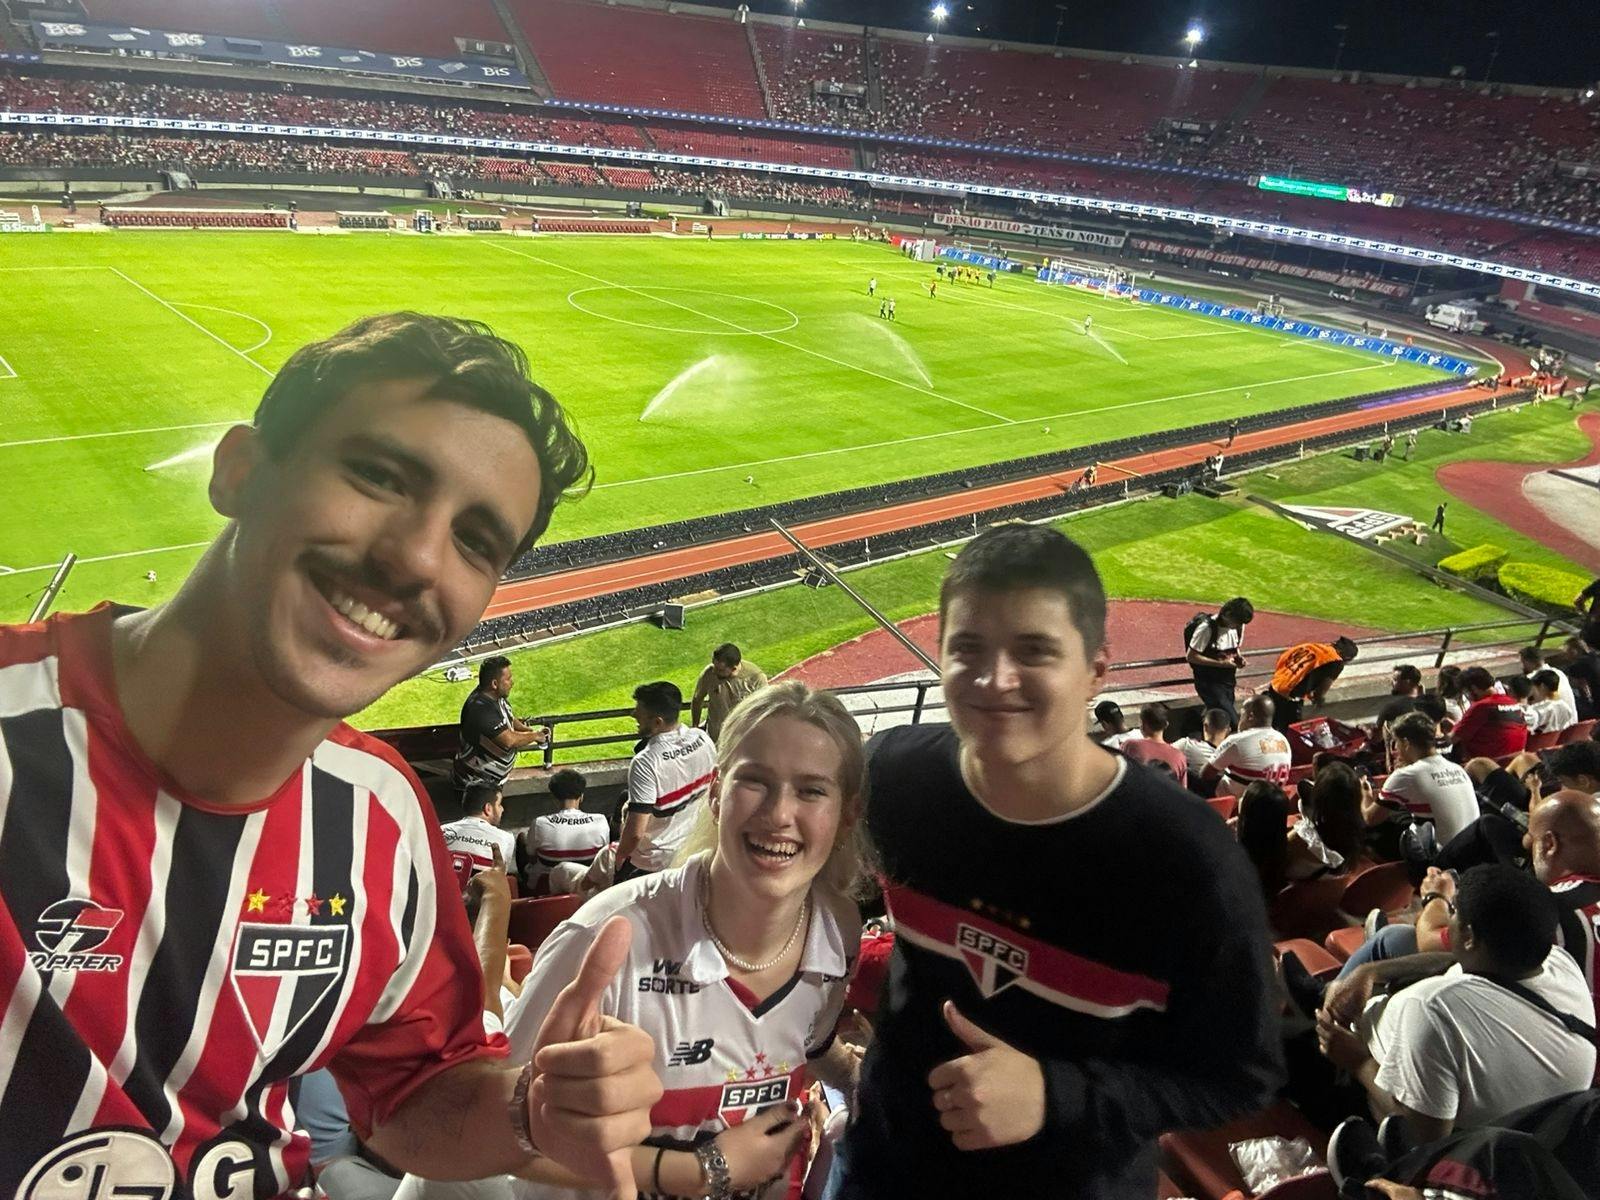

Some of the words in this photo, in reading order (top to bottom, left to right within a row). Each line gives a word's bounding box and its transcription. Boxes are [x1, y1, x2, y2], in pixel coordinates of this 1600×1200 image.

[984, 220, 1020, 232] PAULO
[1034, 227, 1064, 238] TENS
[1066, 231, 1075, 239] O
[1078, 233, 1112, 245] NOME
[662, 735, 706, 761] SUPERBET
[550, 815, 594, 826] SUPERBET
[249, 938, 334, 968] SPFC
[963, 929, 1024, 968] SPFC
[28, 952, 123, 972] OPPER
[638, 976, 701, 994] SORTE
[727, 1084, 783, 1105] SPFC
